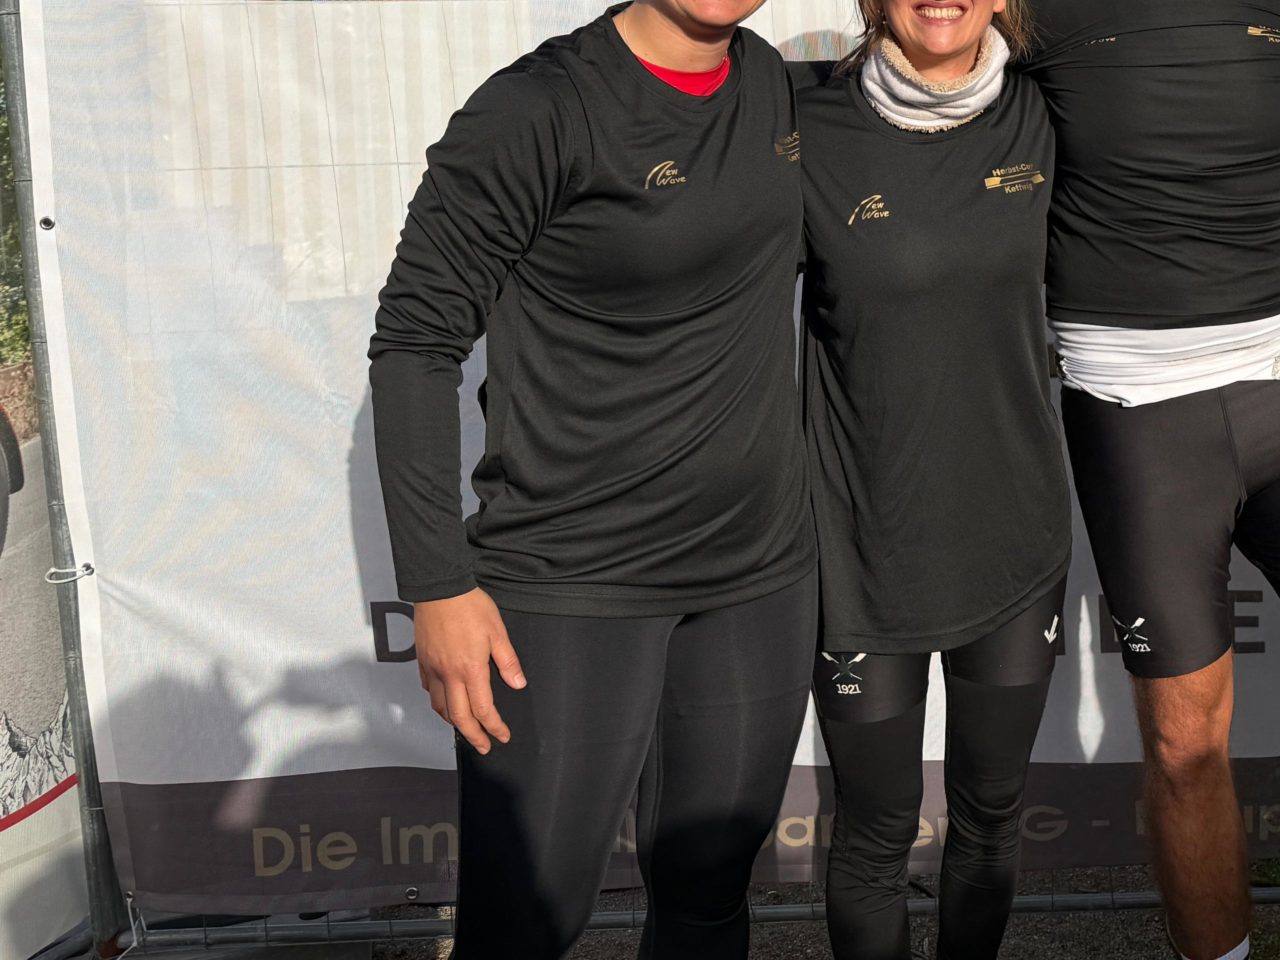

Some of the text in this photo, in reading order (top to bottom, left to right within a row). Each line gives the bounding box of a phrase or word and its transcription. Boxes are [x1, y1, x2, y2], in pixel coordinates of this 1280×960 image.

[1128, 642, 1152, 653] 1921
[835, 683, 862, 695] 1921
[252, 824, 358, 877] Die
